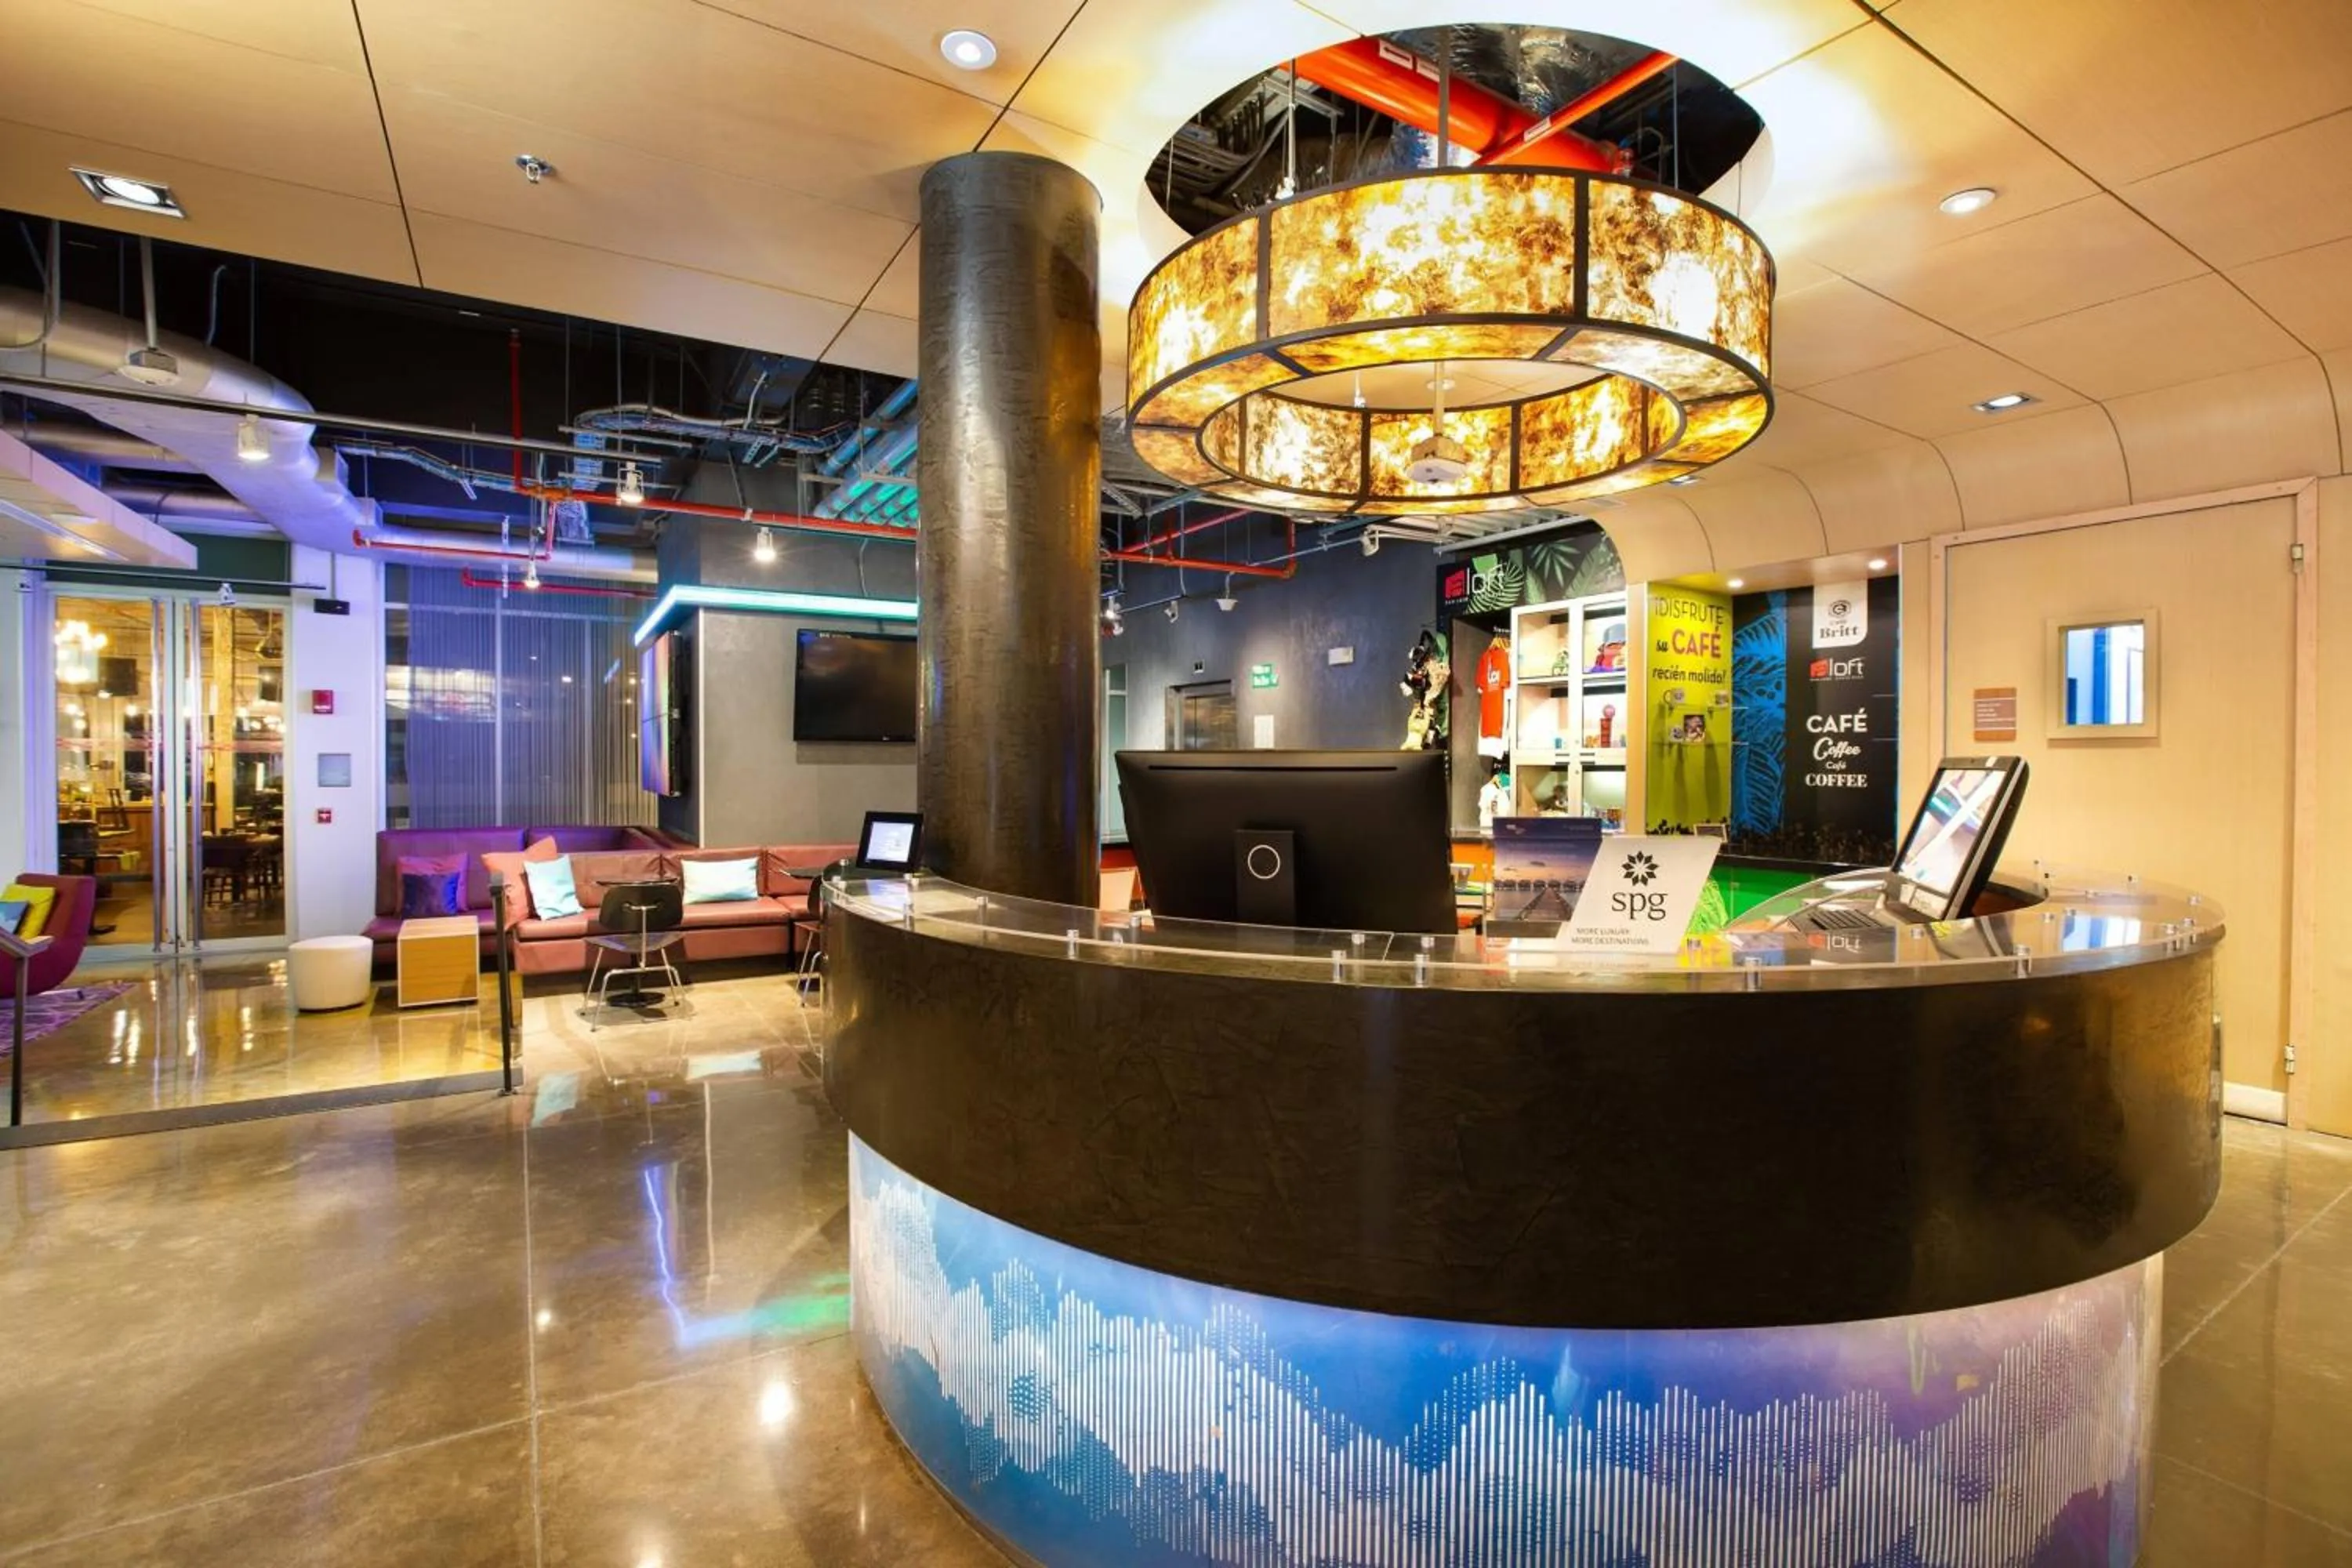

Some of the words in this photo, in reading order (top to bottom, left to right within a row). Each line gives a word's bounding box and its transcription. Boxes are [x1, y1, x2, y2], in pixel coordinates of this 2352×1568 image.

[1656, 640, 1668, 652] su
[1672, 626, 1721, 659] CAFÉ
[1820, 626, 1858, 639] Britt
[1653, 665, 1686, 681] recién
[1688, 668, 1726, 684] molido!
[1806, 707, 1867, 733] CAFÉ
[1813, 736, 1861, 760] Coffee
[1826, 760, 1846, 771] Café
[1805, 773, 1867, 787] COFFEE
[1611, 891, 1668, 921] spg
